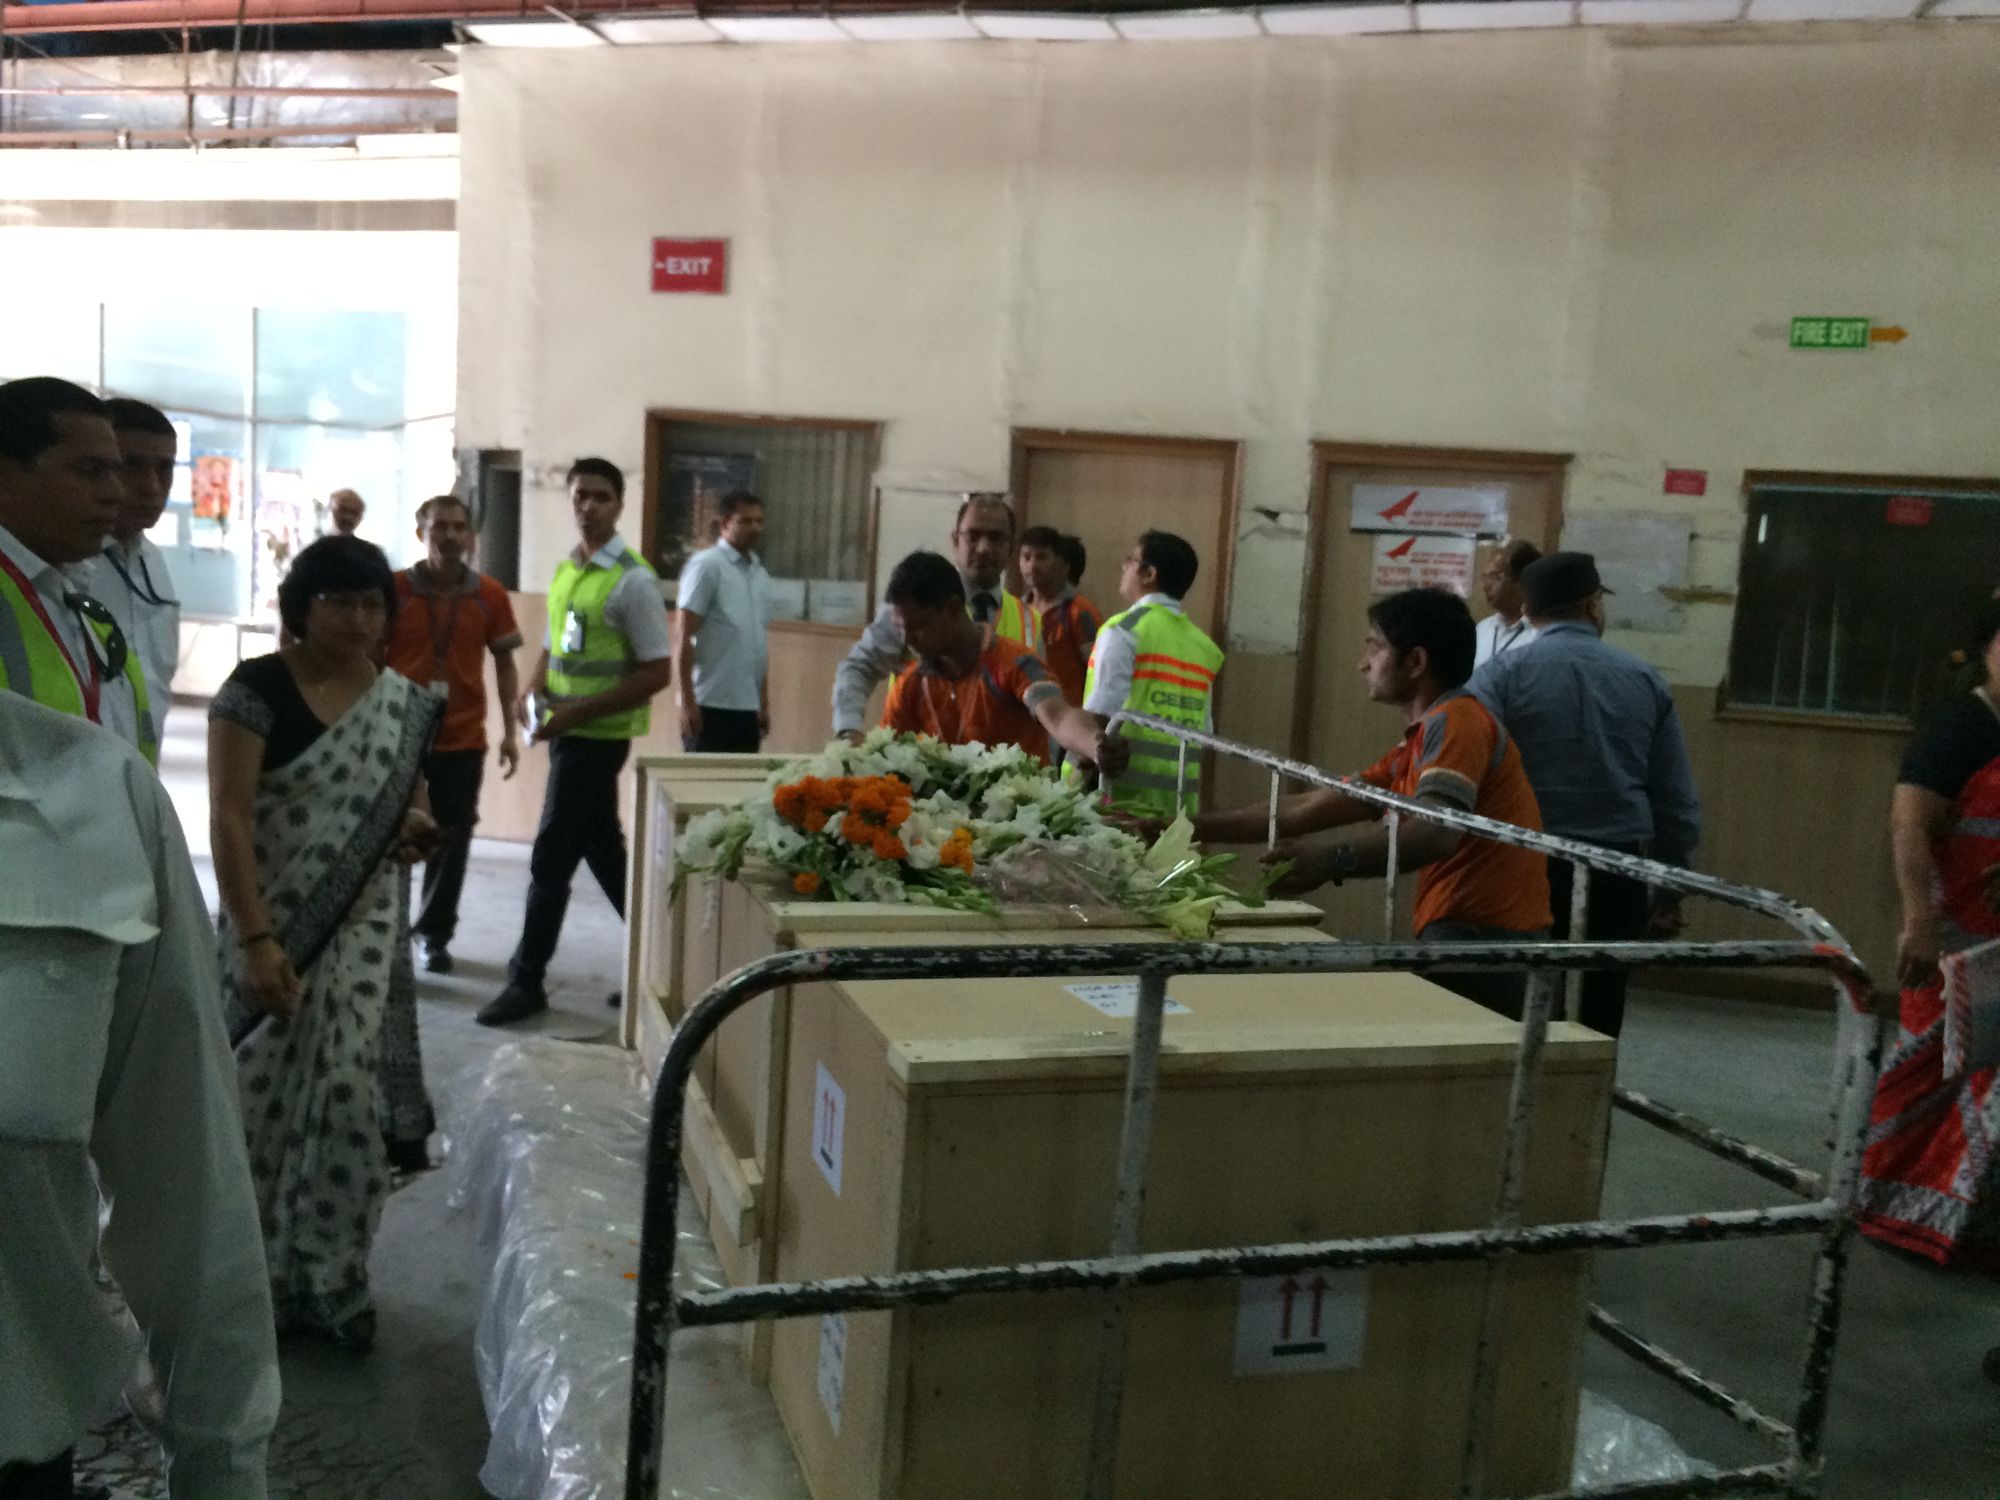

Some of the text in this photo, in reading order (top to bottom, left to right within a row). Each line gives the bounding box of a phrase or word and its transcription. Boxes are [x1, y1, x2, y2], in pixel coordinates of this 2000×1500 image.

[666, 257, 712, 275] EXIT
[1794, 321, 1864, 344] FIRE EXIT
